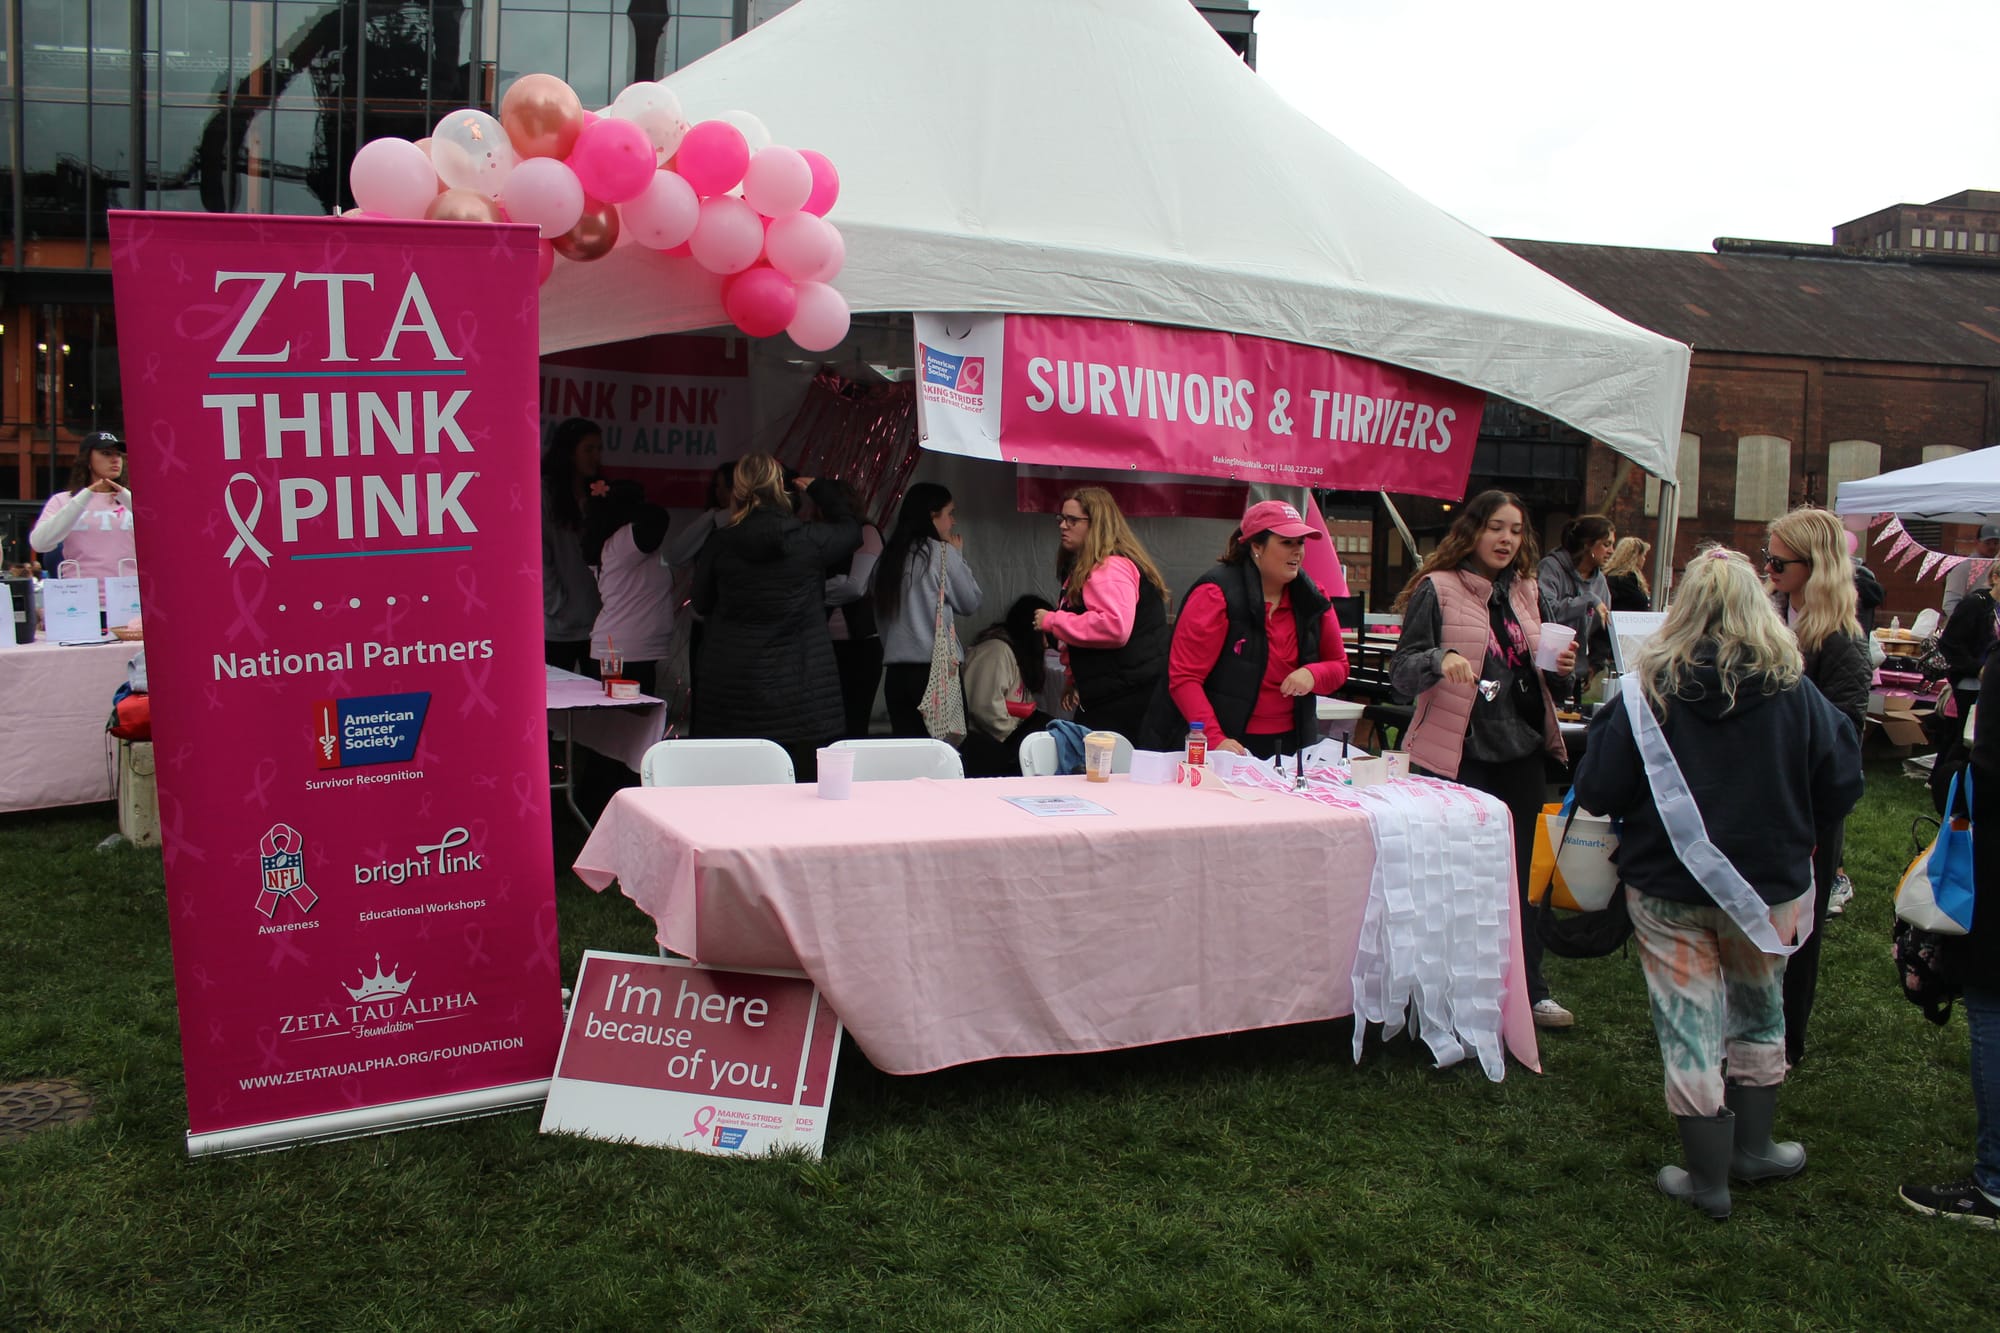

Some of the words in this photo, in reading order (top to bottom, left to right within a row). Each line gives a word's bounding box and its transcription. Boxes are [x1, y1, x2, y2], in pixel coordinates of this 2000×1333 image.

[214, 270, 464, 363] ZTA
[927, 356, 956, 371] American
[630, 384, 721, 425] PINK
[922, 385, 949, 397] AKING
[949, 391, 984, 407] STRIDES
[1026, 357, 1255, 431] SURVIVORS
[1268, 388, 1294, 435] &
[1310, 389, 1457, 454] THRIVERS
[202, 390, 475, 460] THINK
[632, 427, 718, 456] ALPHA
[213, 643, 353, 681] National
[363, 638, 494, 668] Partners
[344, 710, 415, 726] American
[344, 723, 395, 738] Cancer
[305, 777, 354, 791] Survivor
[356, 769, 424, 786] Recognition
[266, 868, 300, 890] NFL
[355, 856, 431, 885] bright
[359, 904, 425, 922] Educational
[426, 898, 487, 914] Workshops
[258, 919, 320, 935] Awareness
[279, 1012, 341, 1035] ZETA
[346, 1002, 395, 1024] TAU
[401, 991, 479, 1016] ALPHA
[604, 973, 662, 1017] I'm
[674, 979, 769, 1028] here
[351, 1020, 415, 1039] Foundation
[584, 1012, 692, 1049] because
[239, 1036, 524, 1090] WWW.ZETATAUALPHA.ORG/FOUNDATION
[667, 1049, 706, 1080] of
[710, 1059, 779, 1090] you.
[717, 1109, 750, 1120] MAKING
[751, 1114, 783, 1124] STRIDES
[796, 1118, 814, 1126] IDES
